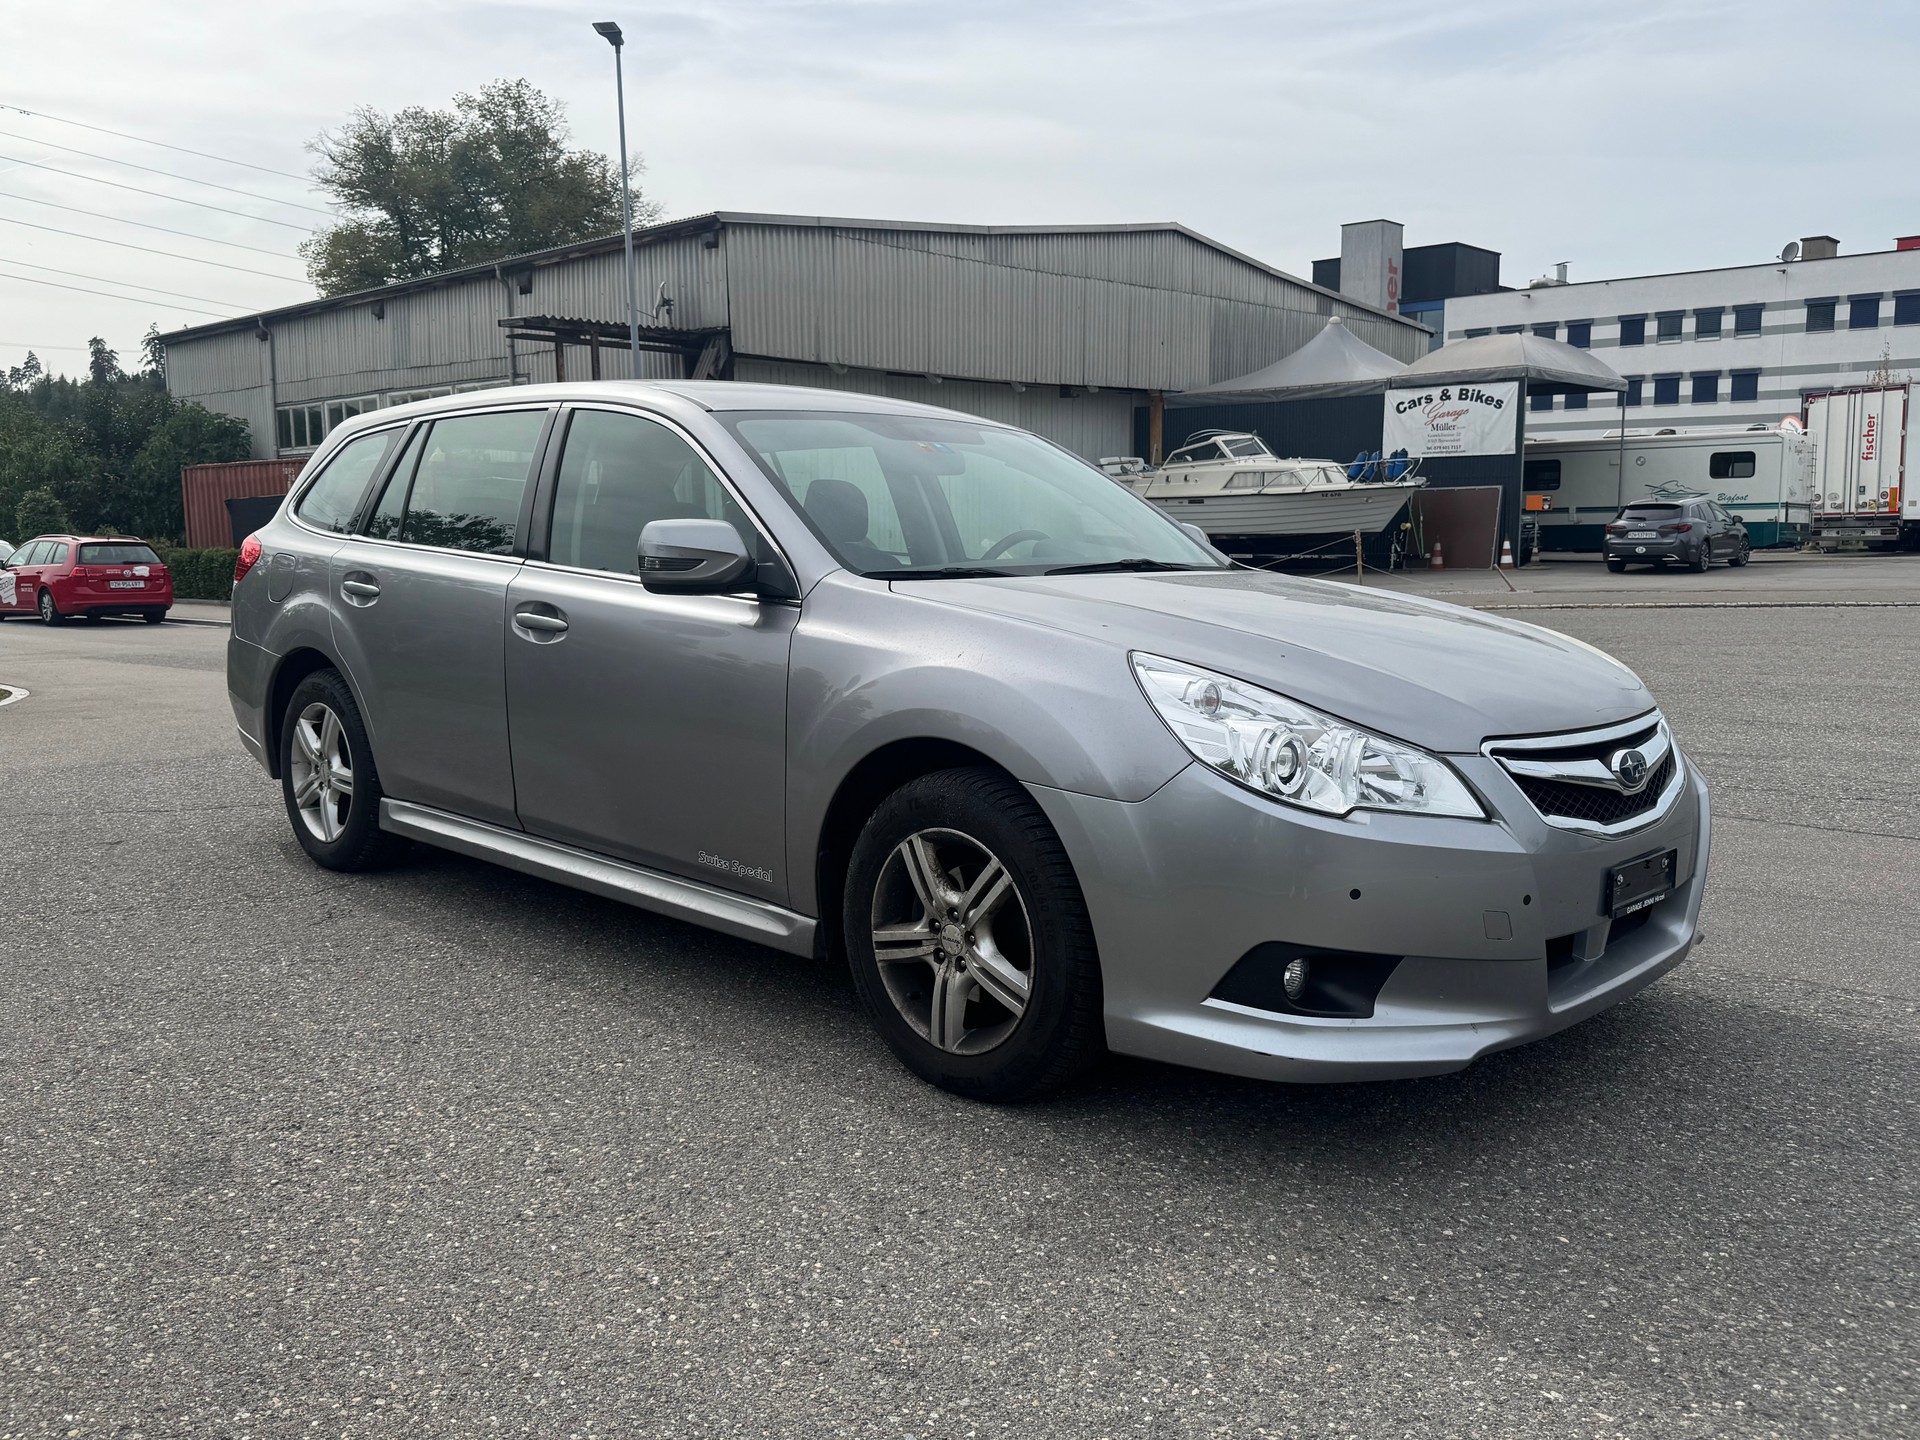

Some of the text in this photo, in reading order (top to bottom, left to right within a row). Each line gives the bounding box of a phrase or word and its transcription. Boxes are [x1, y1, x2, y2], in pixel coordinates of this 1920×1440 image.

[1395, 388, 1504, 414] Cars & Bikes
[1422, 401, 1470, 426] Garage
[1430, 423, 1457, 432] Müller
[1861, 413, 1876, 461] fischer
[1717, 492, 1749, 503] Bigfoot
[698, 850, 773, 883] Swiss Special
[1626, 901, 1643, 914] GARAGE
